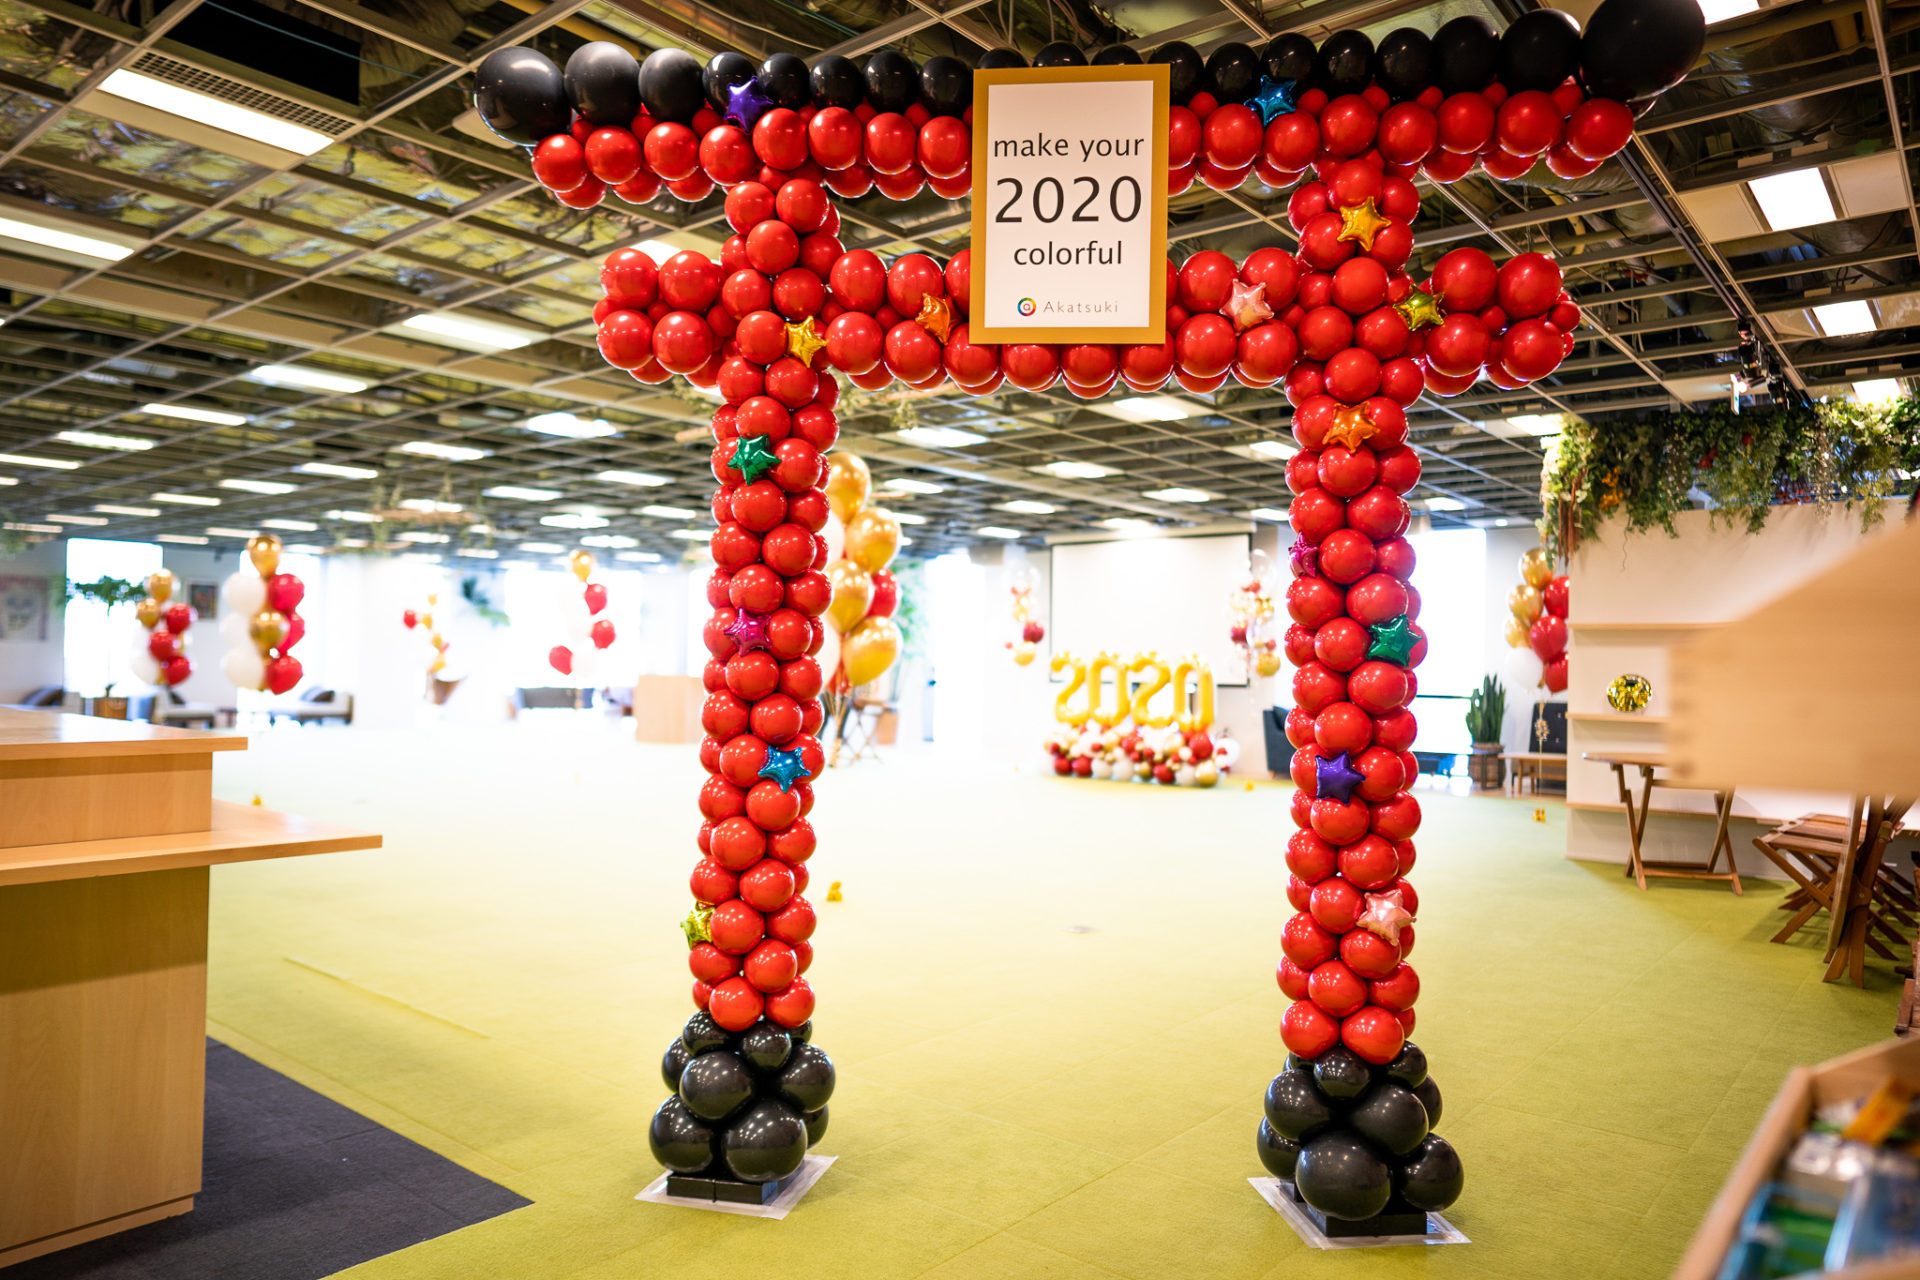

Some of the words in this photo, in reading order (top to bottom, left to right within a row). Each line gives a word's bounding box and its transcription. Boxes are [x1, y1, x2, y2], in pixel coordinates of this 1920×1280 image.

[993, 133, 1069, 157] make
[1080, 137, 1145, 162] your
[995, 175, 1142, 223] 2020
[1013, 240, 1122, 266] colorful
[1043, 300, 1118, 313] Akatsuki
[1050, 651, 1215, 732] 2020
